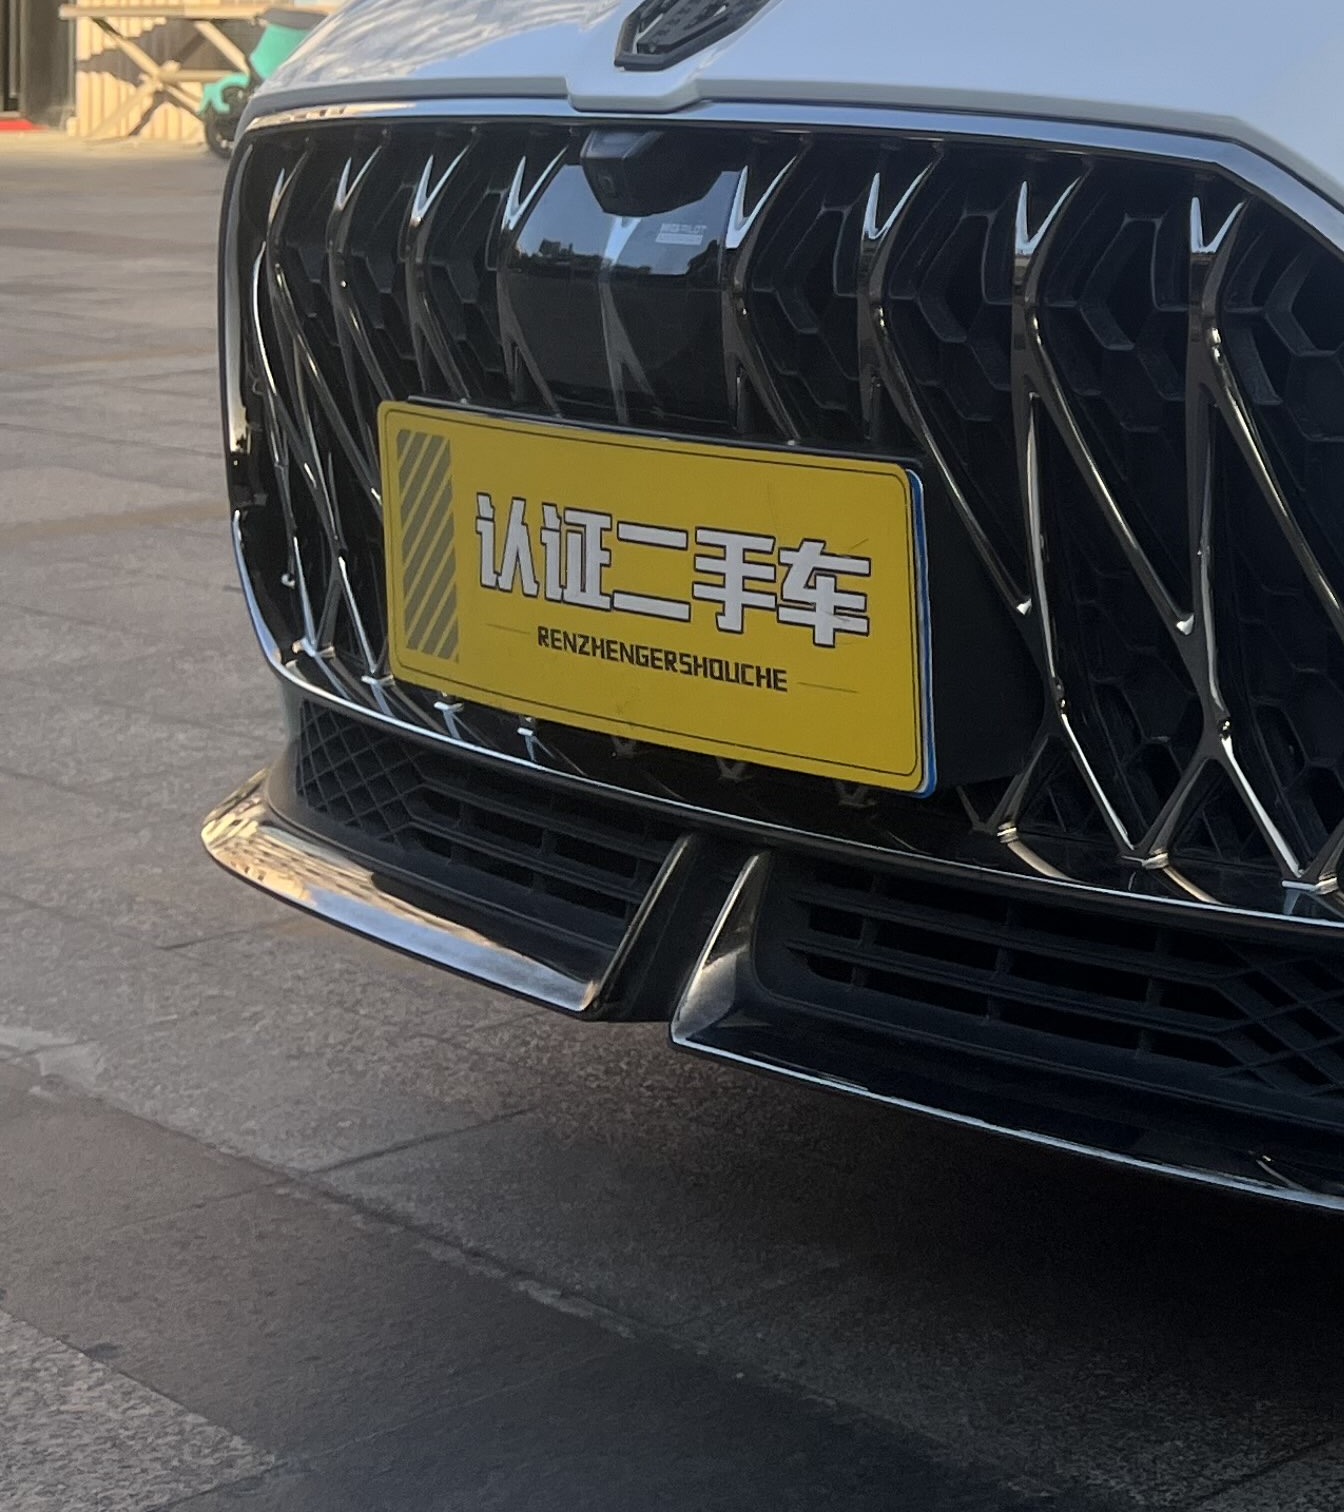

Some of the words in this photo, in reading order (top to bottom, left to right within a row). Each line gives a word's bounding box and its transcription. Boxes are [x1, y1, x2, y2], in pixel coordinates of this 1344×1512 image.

[475, 491, 871, 648] 认证二手车
[537, 625, 789, 692] RENZHENGERSHOUCHE
